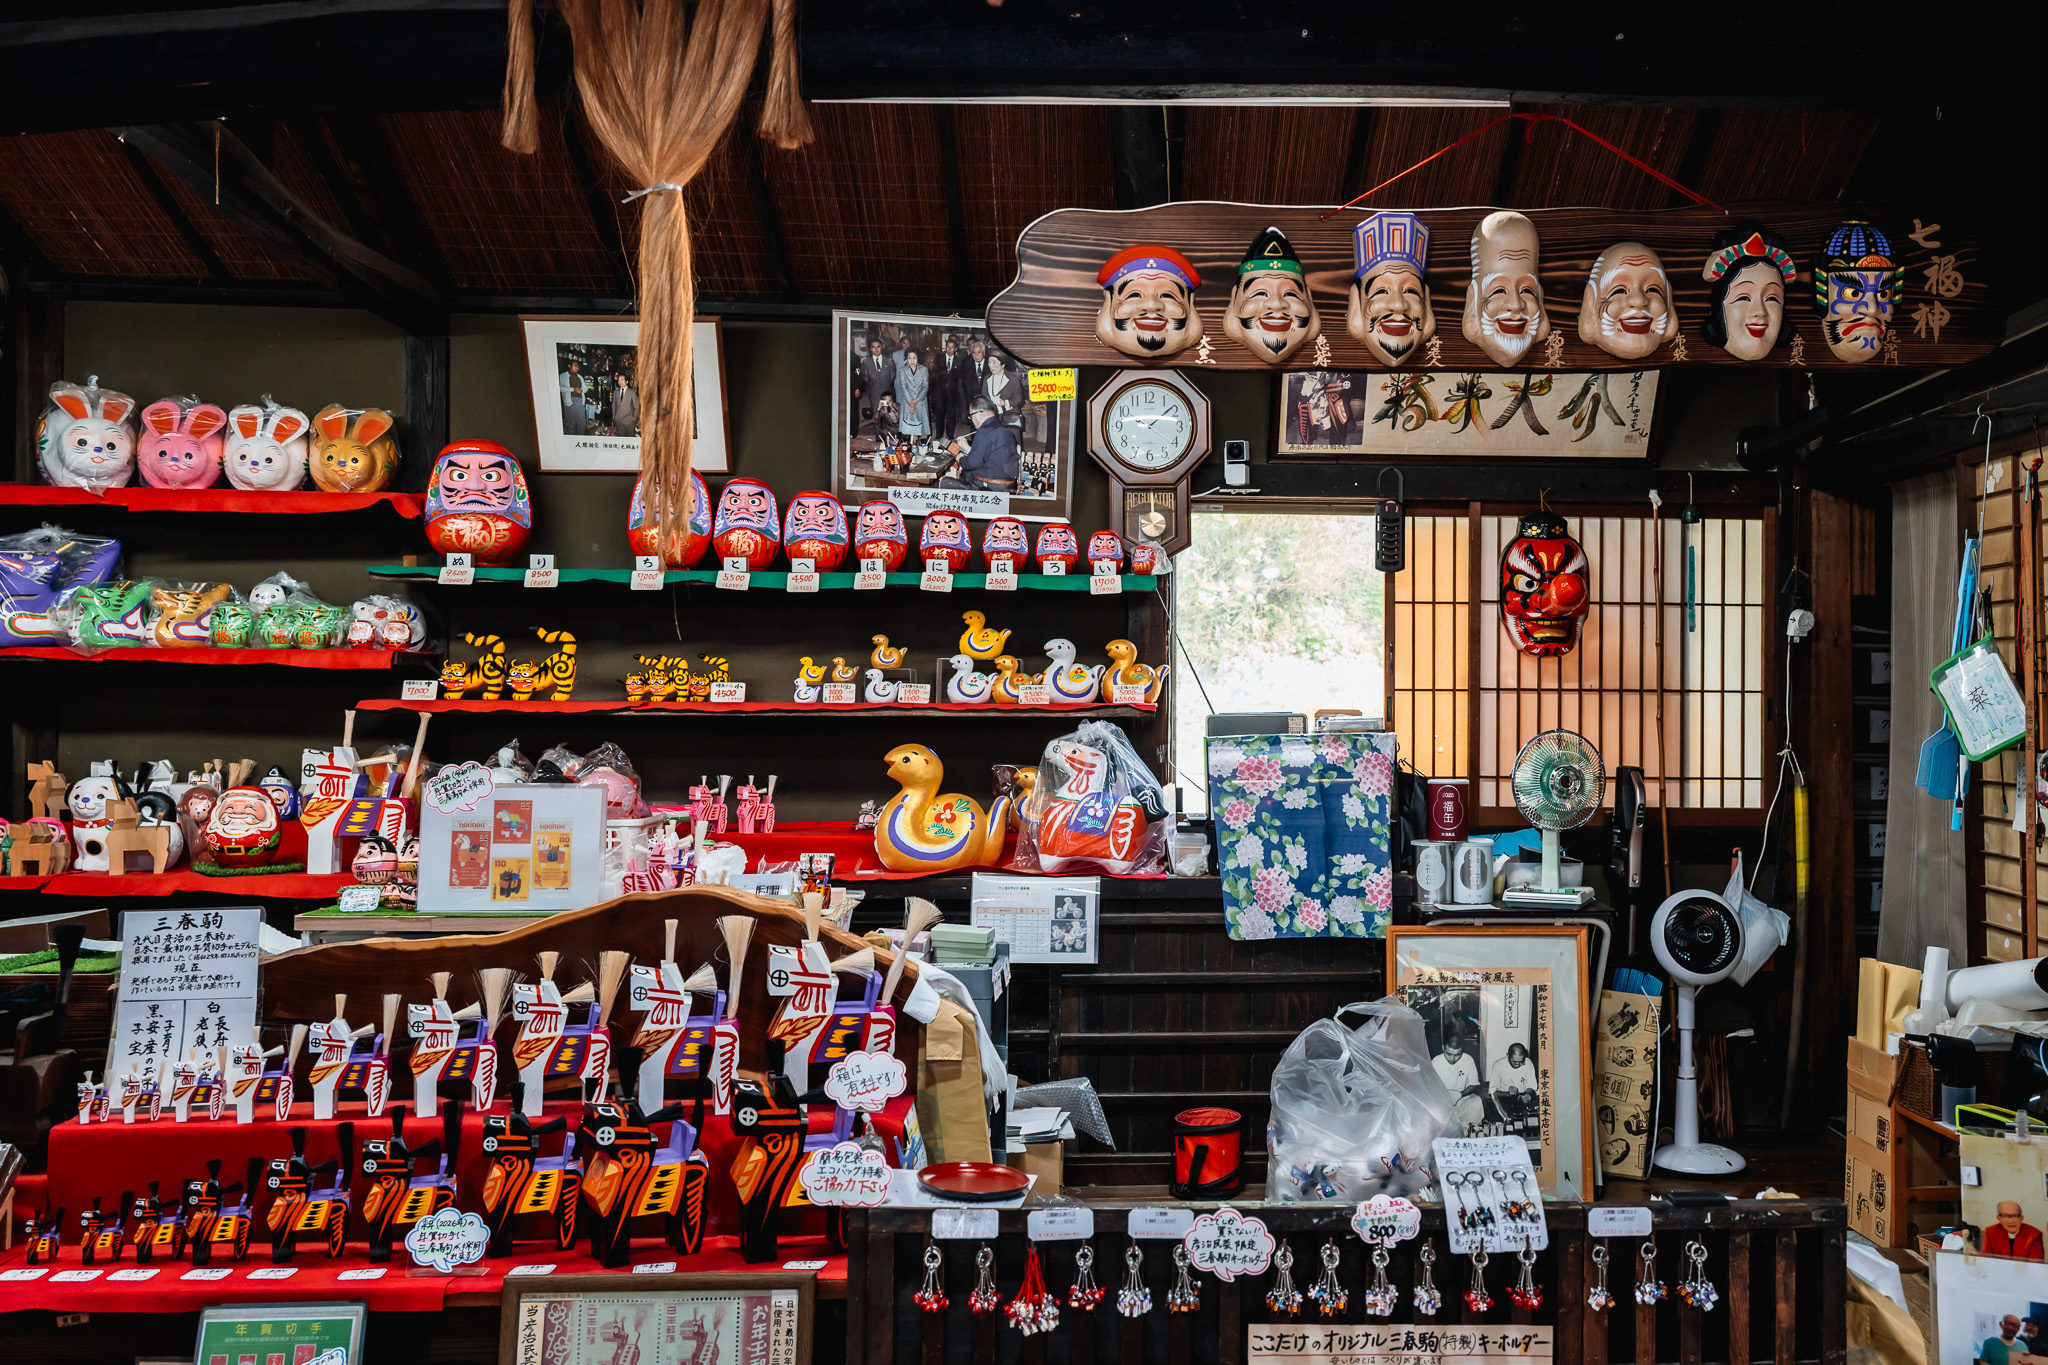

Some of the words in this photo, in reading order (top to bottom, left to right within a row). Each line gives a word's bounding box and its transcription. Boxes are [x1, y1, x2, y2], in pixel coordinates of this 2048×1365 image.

[1908, 218, 1963, 343] 七福神
[1195, 335, 1216, 364] 大黒
[1425, 335, 1446, 367] 寿老人
[1669, 332, 1690, 362] 布袋
[1789, 334, 1806, 366] 弁財天
[1883, 329, 1901, 365] 毘沙門
[1131, 395, 1140, 407] 11
[1144, 391, 1155, 403] 12
[1162, 395, 1166, 407] 1
[1119, 405, 1130, 417] 10
[1115, 421, 1123, 432] 9
[1176, 421, 1184, 432] 3
[1120, 435, 1128, 447] 8
[1172, 437, 1179, 447] 4
[1146, 449, 1154, 462] 6
[1161, 446, 1169, 458] 5
[892, 489, 1002, 505] 秩父宮妃殿下御高覧記念
[1127, 492, 1175, 511] REGUATOR
[452, 557, 465, 566] ぬ
[537, 557, 546, 569] り
[643, 558, 653, 568] ち
[731, 560, 740, 570] と
[866, 561, 878, 572] ほ
[932, 562, 944, 572] に
[997, 563, 1007, 573] は
[1050, 563, 1060, 573] ろ
[1099, 565, 1111, 573] い
[1443, 801, 1454, 823] 福缶
[153, 912, 223, 931] 三春駒
[133, 932, 235, 946] 九代目彦治の三春駒が
[134, 942, 257, 955] 日本で最初の年賀切手のモデルに
[174, 963, 202, 973] 現在
[146, 1004, 163, 1018] 黒
[206, 1001, 221, 1014] 白
[1537, 984, 1548, 1050] 昭和二十七年九月
[212, 1015, 231, 1047] 長寿
[128, 1023, 144, 1056] 子宝
[162, 1020, 175, 1057] 子育て
[835, 1064, 862, 1083] 箱は
[1540, 1069, 1552, 1146] 東京三越本店にて
[819, 1151, 864, 1165] 簡易包装
[817, 1165, 885, 1178] エコバッグ持参
[813, 1177, 887, 1194] ご協力下さい
[421, 1218, 475, 1230] 来年(2026年)の
[1202, 1215, 1237, 1227] ここでしか
[417, 1231, 466, 1242] 年賀切手に
[1369, 1225, 1396, 1240] 800
[1397, 1224, 1416, 1236] (880)
[1199, 1251, 1267, 1266] 三春駒キーホルダー
[236, 1322, 322, 1336] 年賀切手
[666, 1306, 676, 1344] 日本郵便
[784, 1300, 795, 1365] 日本で最初の年
[1252, 1330, 1551, 1356] ここだけのオリジナル三春駒(特製)キーホルダー
